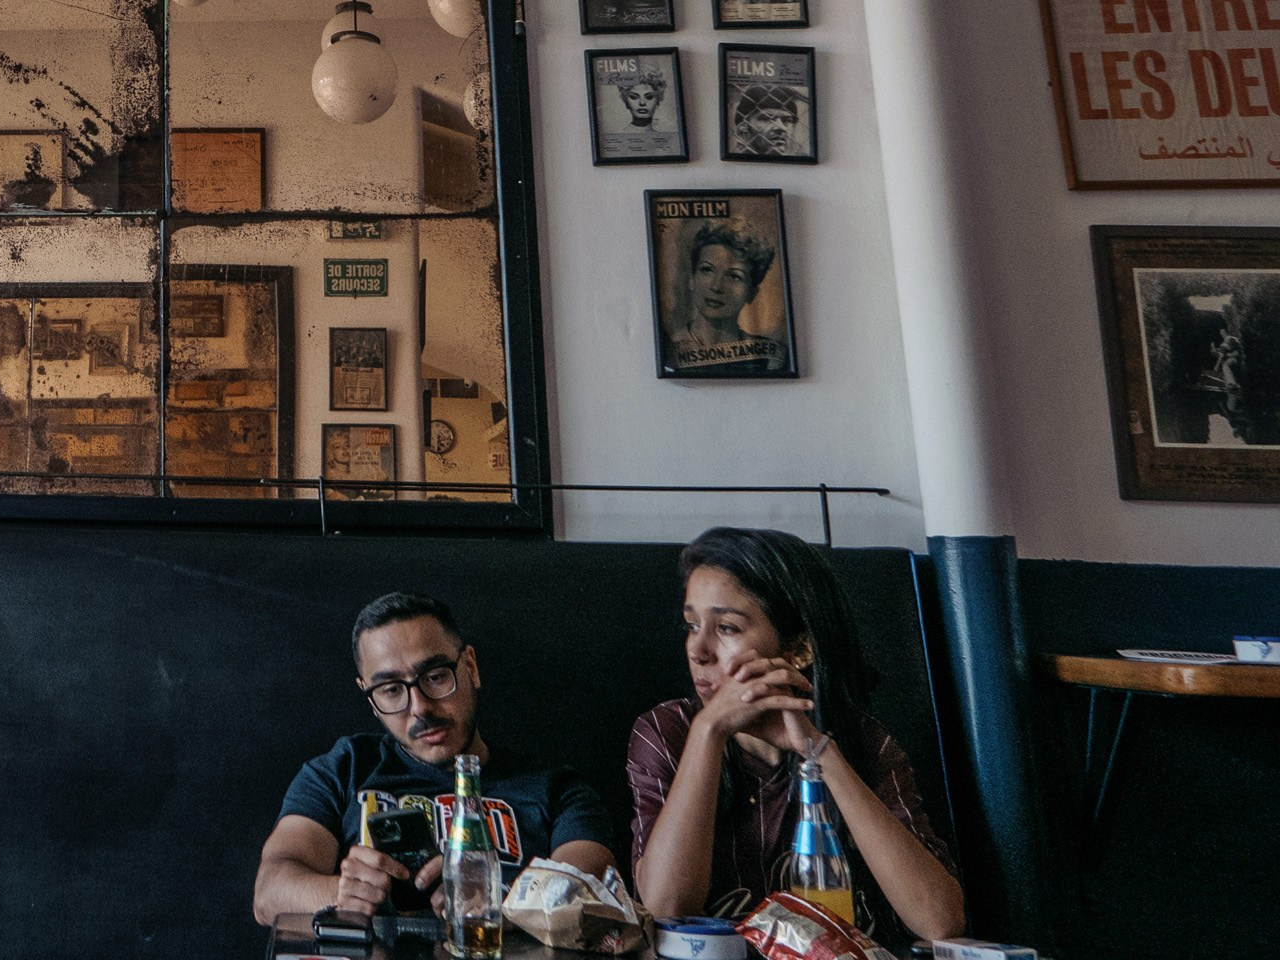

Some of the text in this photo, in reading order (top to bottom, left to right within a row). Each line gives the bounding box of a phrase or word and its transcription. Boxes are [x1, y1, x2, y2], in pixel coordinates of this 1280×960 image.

[597, 58, 637, 73] FILMS
[727, 59, 775, 77] FILMS
[1069, 49, 1176, 121] LES
[1138, 137, 1254, 161] المنتصف
[656, 202, 728, 218] MON FILM
